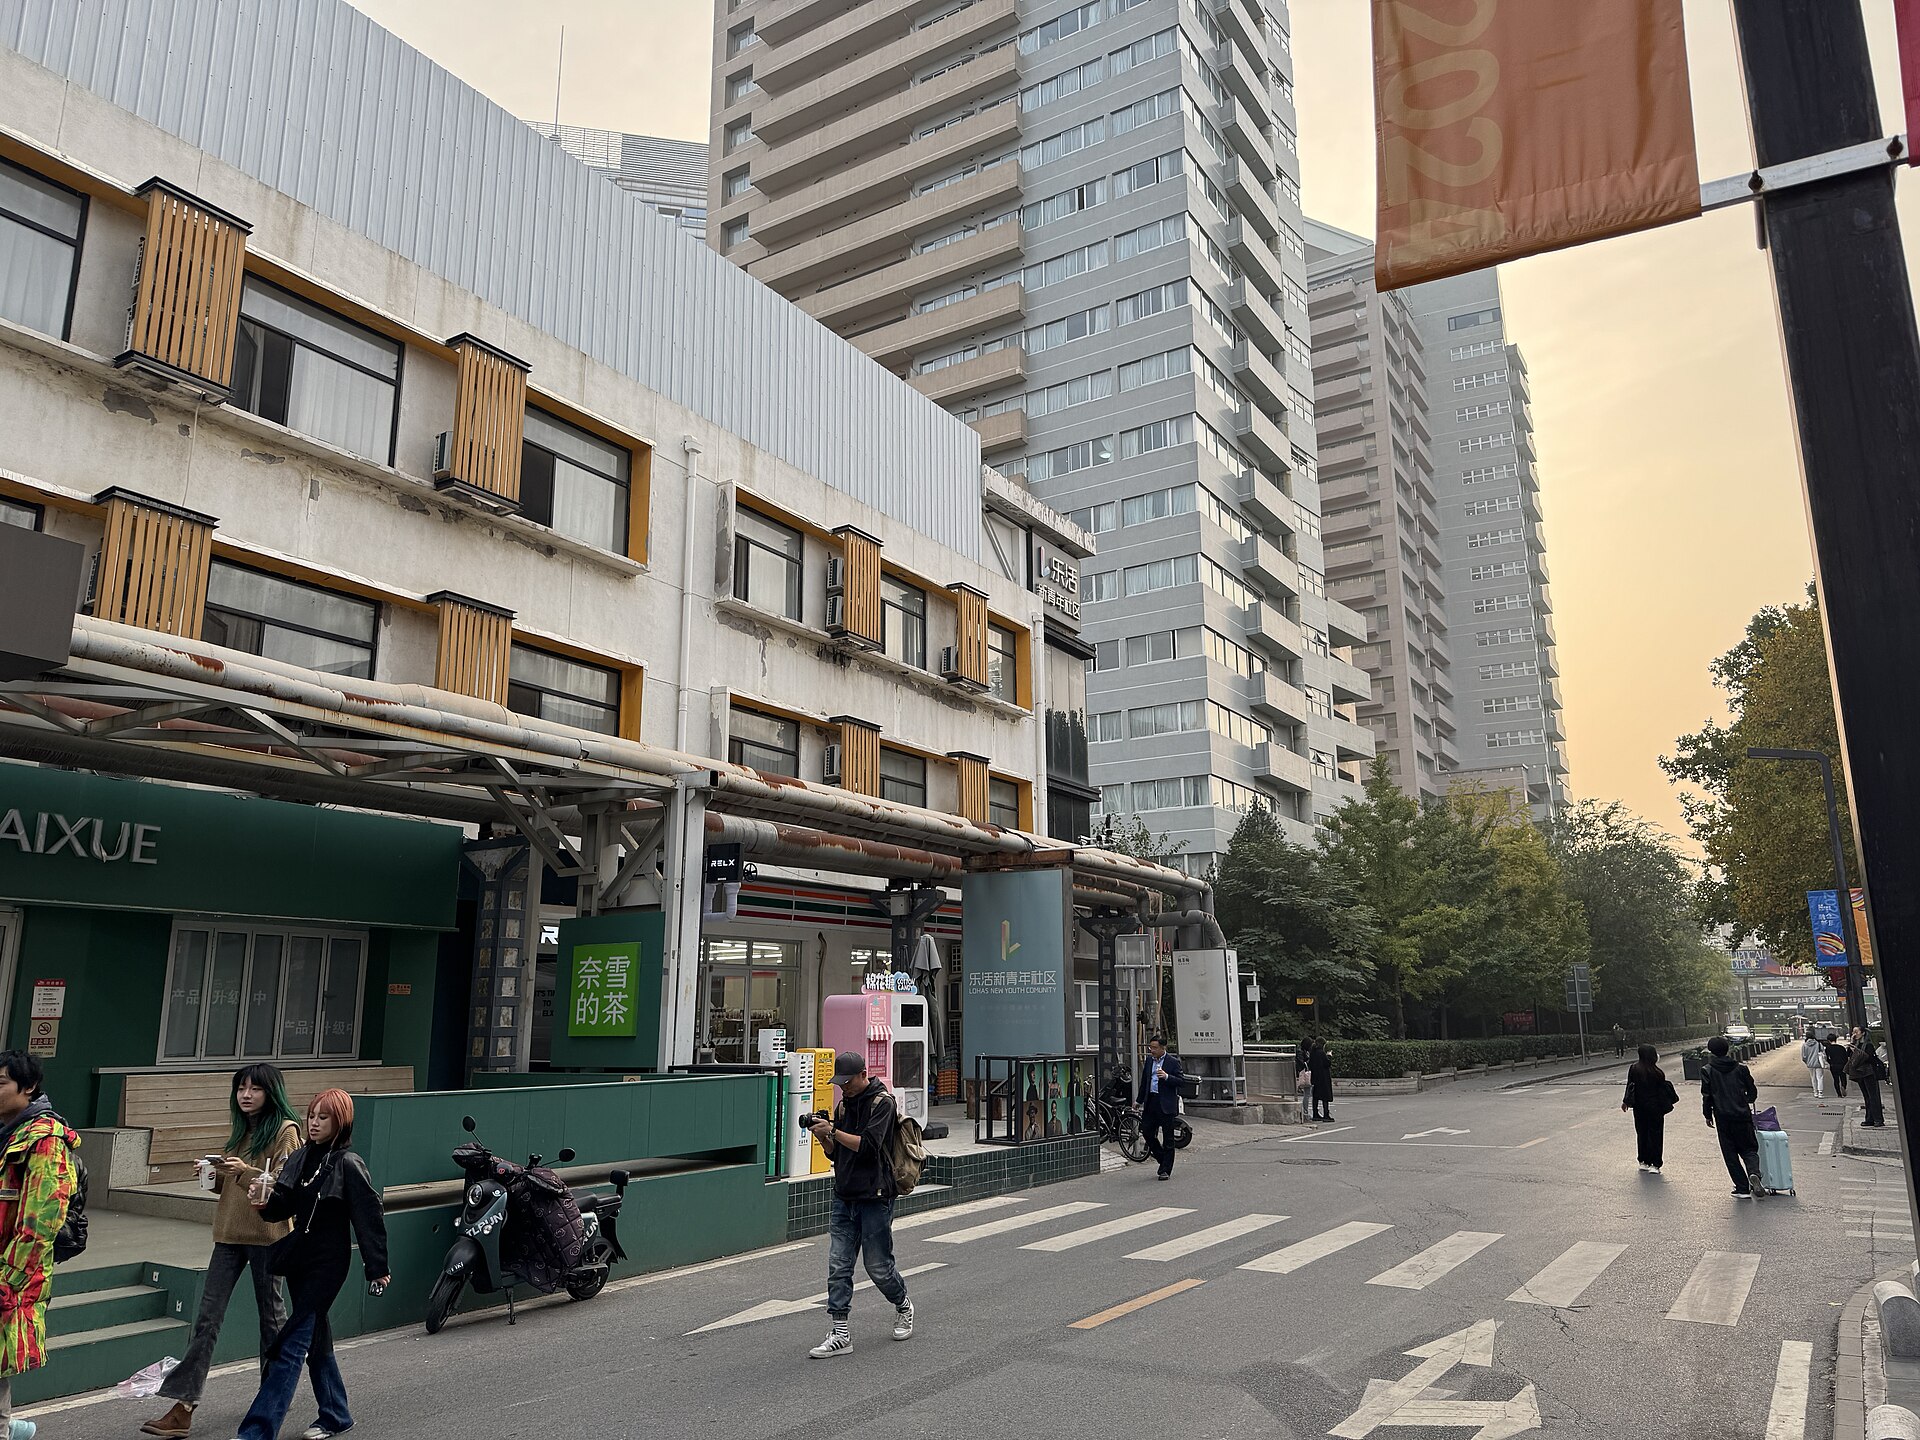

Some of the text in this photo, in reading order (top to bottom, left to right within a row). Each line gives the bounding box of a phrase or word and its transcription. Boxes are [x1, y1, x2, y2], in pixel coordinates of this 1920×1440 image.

[1051, 556, 1078, 594] 乐活
[1036, 583, 1081, 621] 新青年社区
[0, 808, 162, 865] AIXUE
[710, 858, 736, 868] RELX
[577, 955, 631, 990] 奈雪
[969, 970, 1056, 986] 乐活新青年社区
[1026, 986, 1057, 994] COMUNITY
[575, 991, 629, 1026] 的茶
